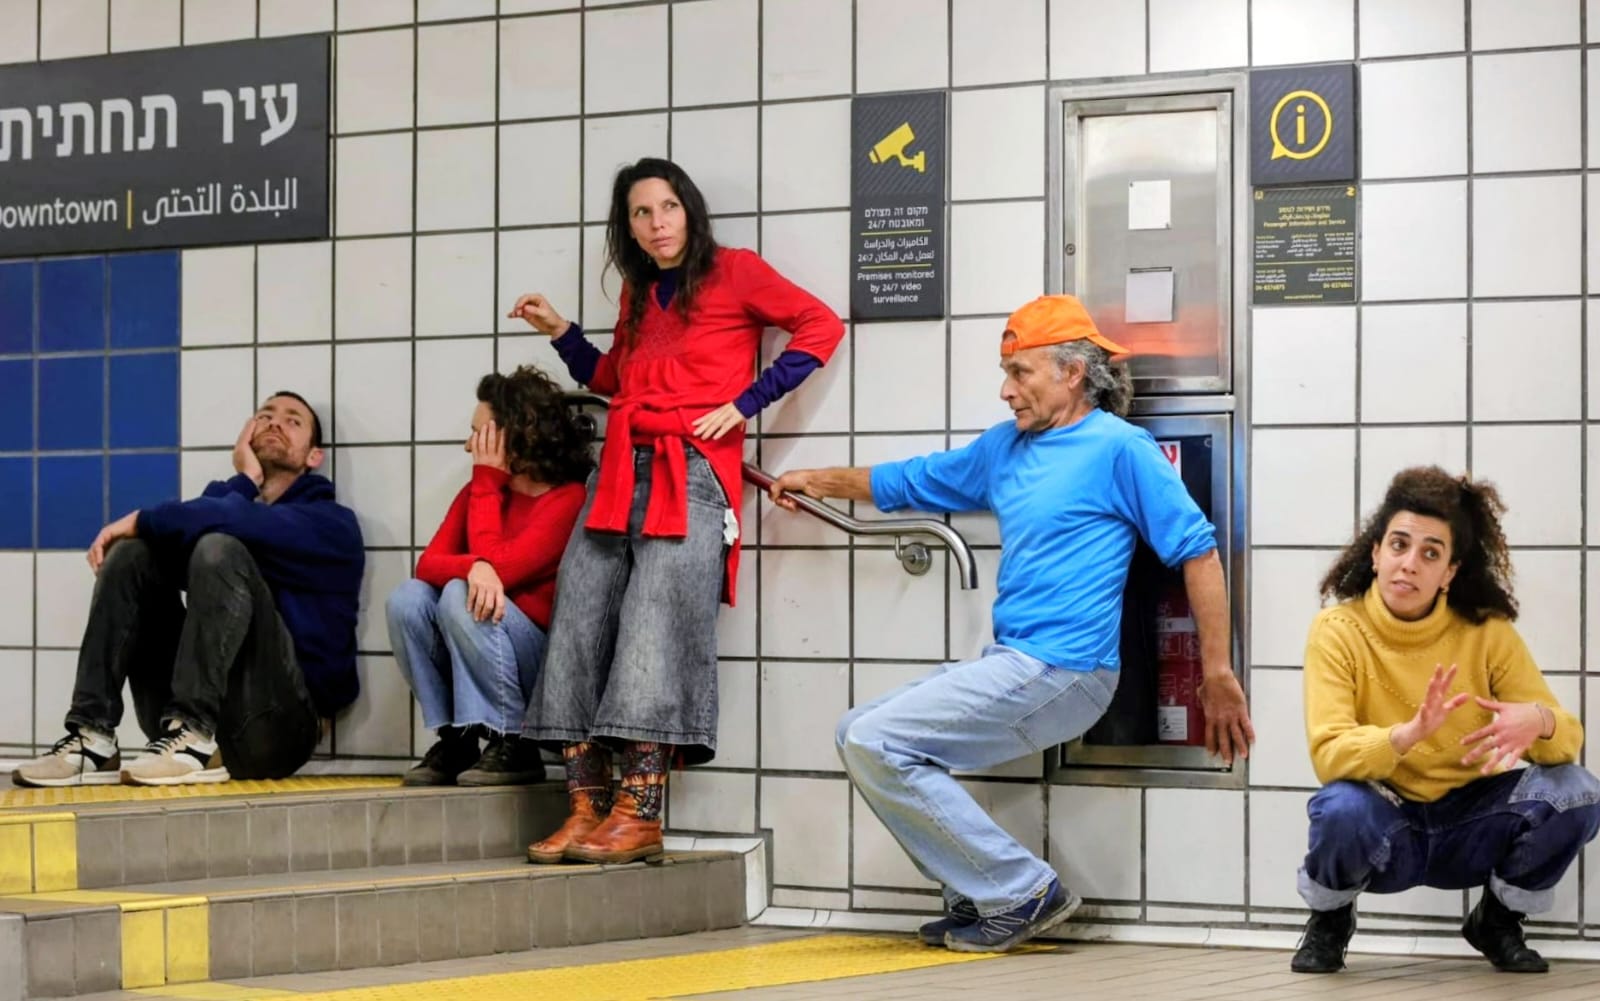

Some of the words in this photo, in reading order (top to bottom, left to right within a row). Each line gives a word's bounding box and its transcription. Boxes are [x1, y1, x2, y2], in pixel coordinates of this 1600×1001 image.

[202, 83, 297, 146] עיר
[0, 94, 178, 162] תחתית
[230, 177, 297, 218] البلدة
[0, 197, 118, 228] owntown
[864, 208, 891, 218] מצולם
[894, 207, 904, 216] זה
[907, 206, 928, 216] מקום
[868, 220, 886, 229] 24/7
[889, 219, 924, 228] ומאובטח
[875, 251, 898, 263] المكان
[899, 251, 914, 262] في
[857, 272, 892, 281] Premises
[895, 270, 935, 279] monitored
[870, 284, 879, 293] by
[882, 283, 898, 292] 24/7
[901, 281, 922, 291] video
[873, 294, 919, 304] surveillance
